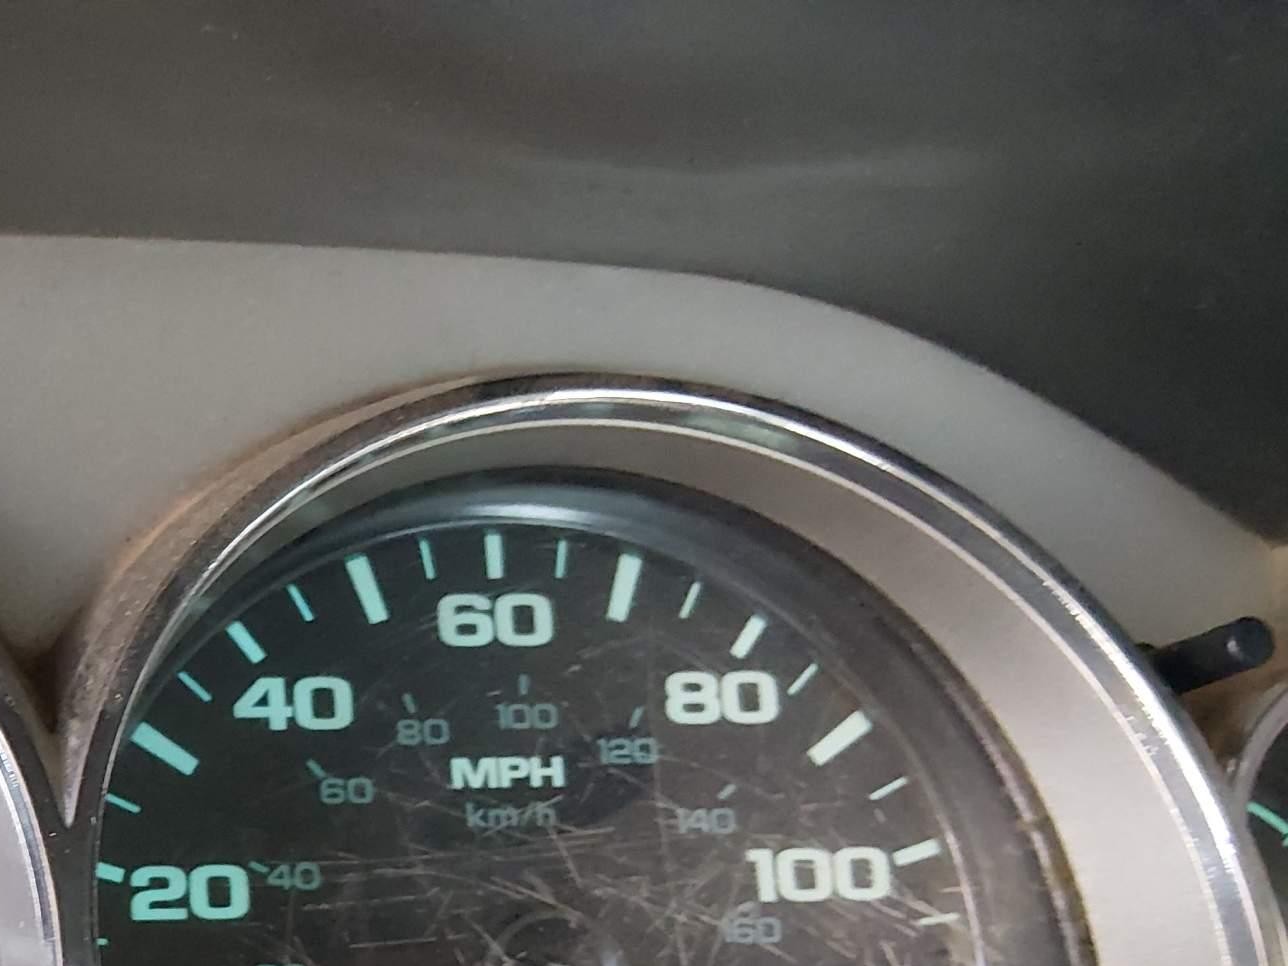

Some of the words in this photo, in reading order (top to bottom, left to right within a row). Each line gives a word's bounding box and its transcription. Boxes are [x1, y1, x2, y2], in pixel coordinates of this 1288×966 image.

[437, 593, 554, 648] 60
[233, 676, 354, 731] 40
[665, 670, 780, 726] 80
[495, 702, 559, 730] 100
[396, 718, 450, 746] 80
[597, 737, 659, 765] 120
[450, 755, 566, 791] MPH
[319, 776, 374, 804] 60
[466, 802, 557, 828] km/h
[677, 807, 737, 834] 140
[266, 862, 322, 891] 40
[745, 845, 892, 902] 100
[129, 863, 250, 922] 20
